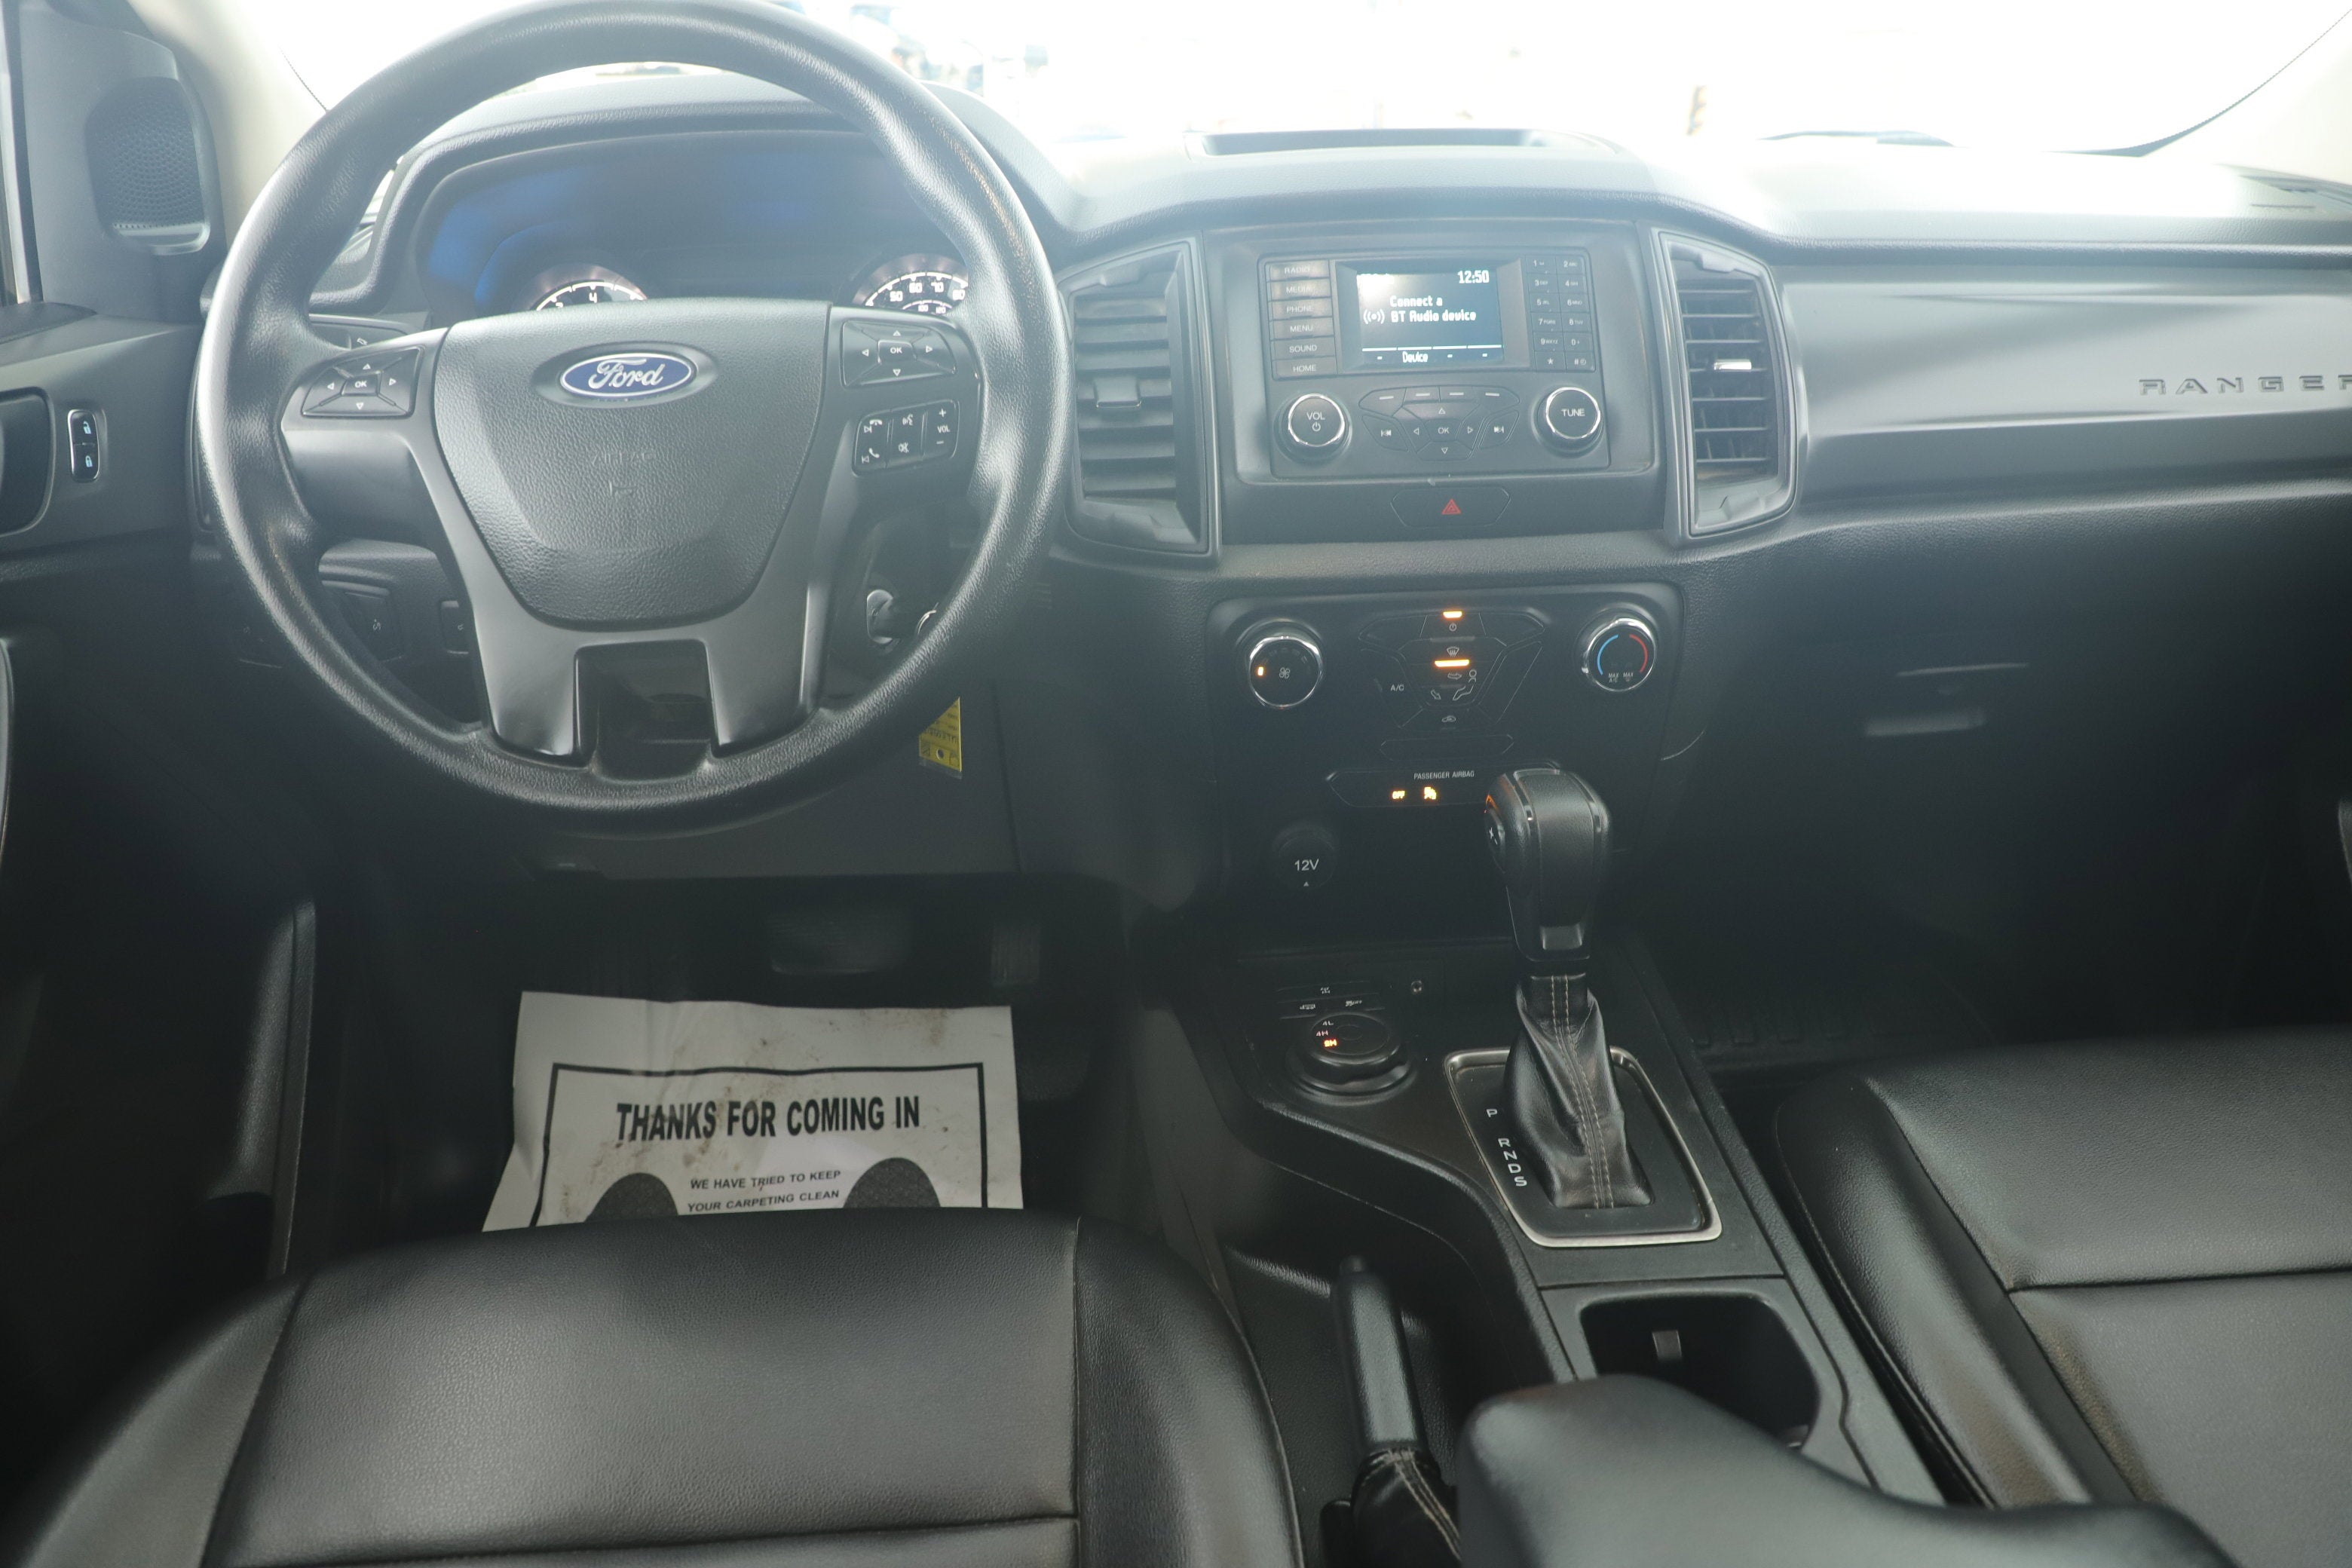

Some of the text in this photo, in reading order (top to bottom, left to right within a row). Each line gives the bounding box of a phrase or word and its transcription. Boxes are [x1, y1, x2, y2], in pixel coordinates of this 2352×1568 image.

[1284, 265, 1310, 274] RADIO
[1457, 269, 1490, 283] 12:50
[931, 282, 944, 292] 70
[1286, 285, 1312, 294] MEDIA
[589, 292, 597, 303] 4
[890, 291, 903, 302] 50
[1389, 295, 1443, 308] Connect a
[1286, 305, 1314, 314] PHONE
[1391, 308, 1476, 323] BT Audio device
[1290, 324, 1313, 332] MENU
[1289, 345, 1318, 354] SOUND
[1402, 351, 1429, 363] Device
[1293, 364, 1316, 372] HOME
[588, 358, 666, 390] Ford
[1306, 412, 1325, 421] VOL
[1560, 408, 1585, 418] TUNE
[1438, 427, 1450, 435] OK
[1413, 771, 1450, 780] PASSENGER
[1392, 790, 1405, 799] OFF
[1294, 859, 1319, 871] 12V
[617, 1095, 920, 1141] THANKS FOR COMING IN
[1486, 1108, 1498, 1118] P
[1498, 1138, 1511, 1147] R
[1503, 1150, 1517, 1161] N
[1508, 1163, 1521, 1174] D
[691, 1170, 841, 1190] WE HAVE TRIED TO KEEP
[1514, 1176, 1527, 1187] S
[688, 1190, 840, 1213] YOUR CARPETING CLEAN
